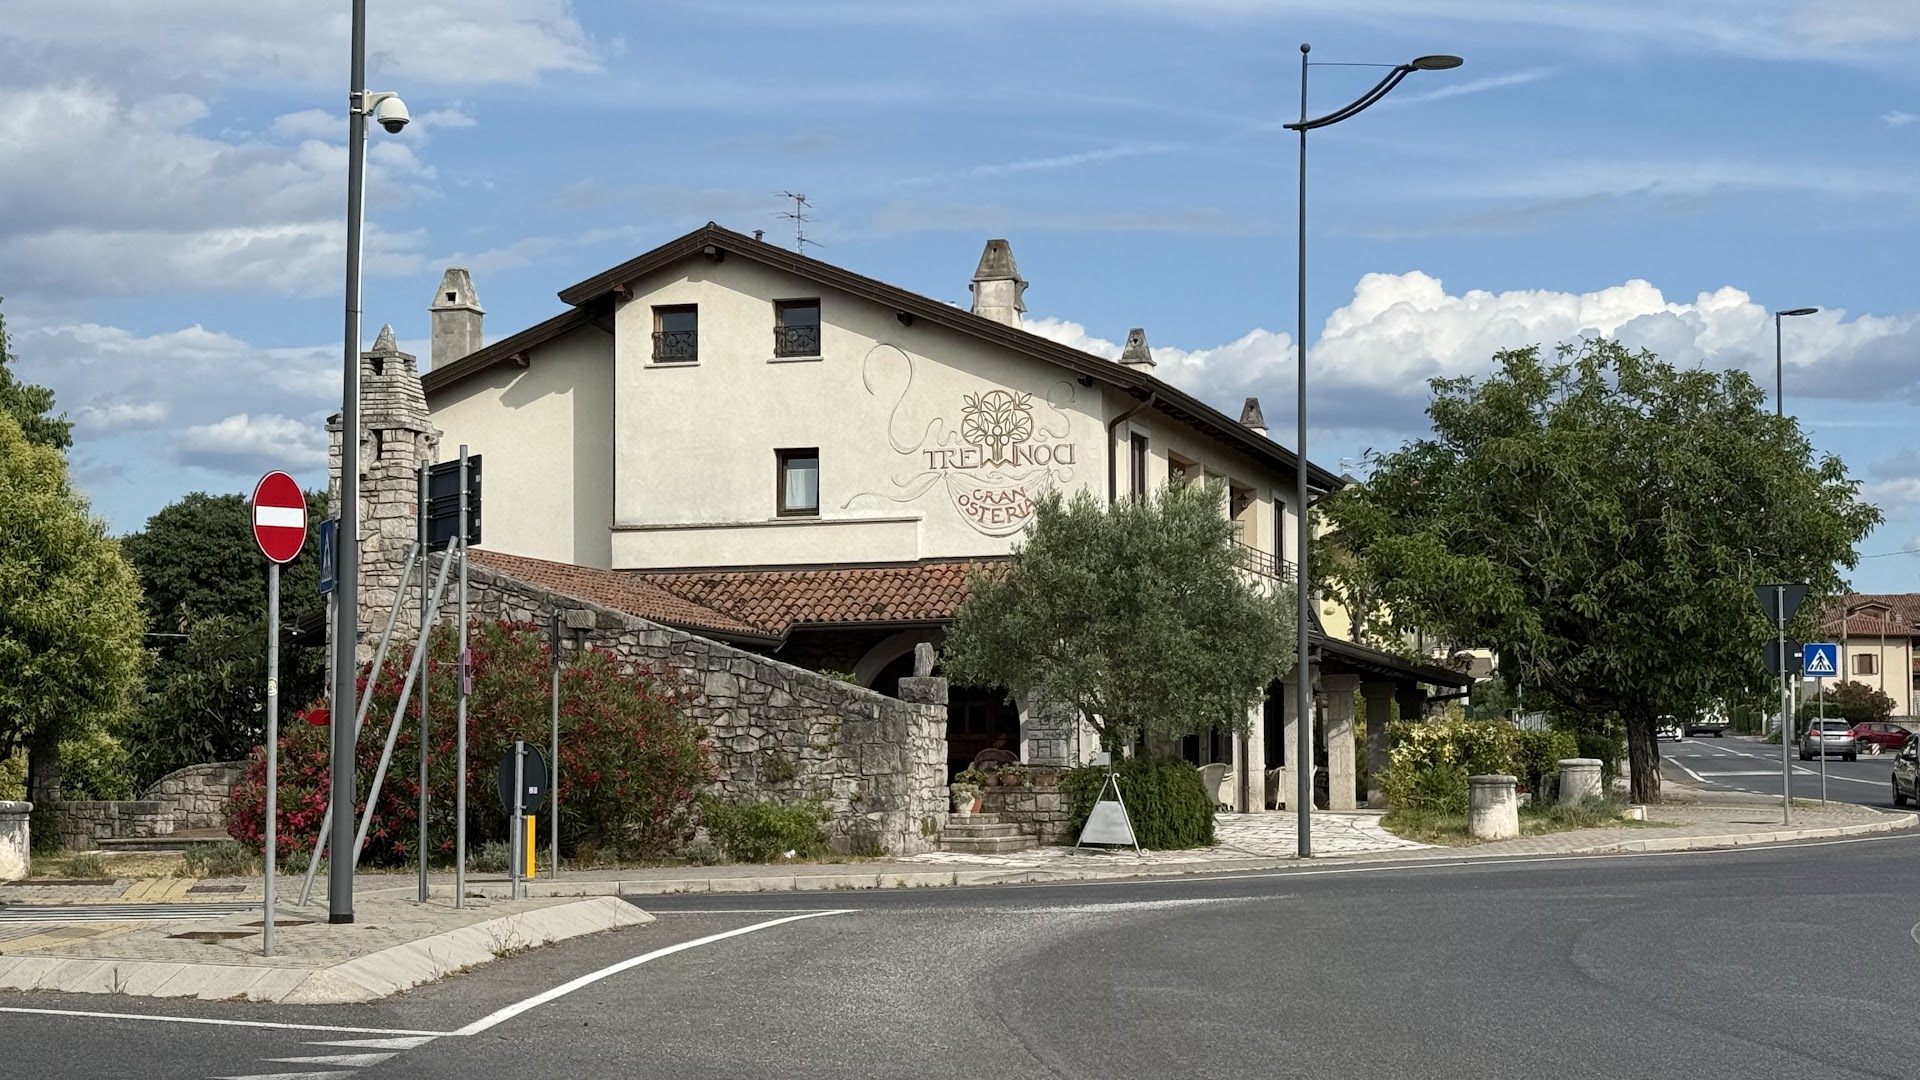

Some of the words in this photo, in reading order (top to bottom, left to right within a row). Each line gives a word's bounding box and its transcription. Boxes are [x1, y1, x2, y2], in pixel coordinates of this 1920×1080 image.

[923, 448, 979, 470] TRE
[1014, 443, 1077, 466] NOCI
[972, 486, 1027, 504] GRAN
[958, 494, 1036, 524] OSTERIA
